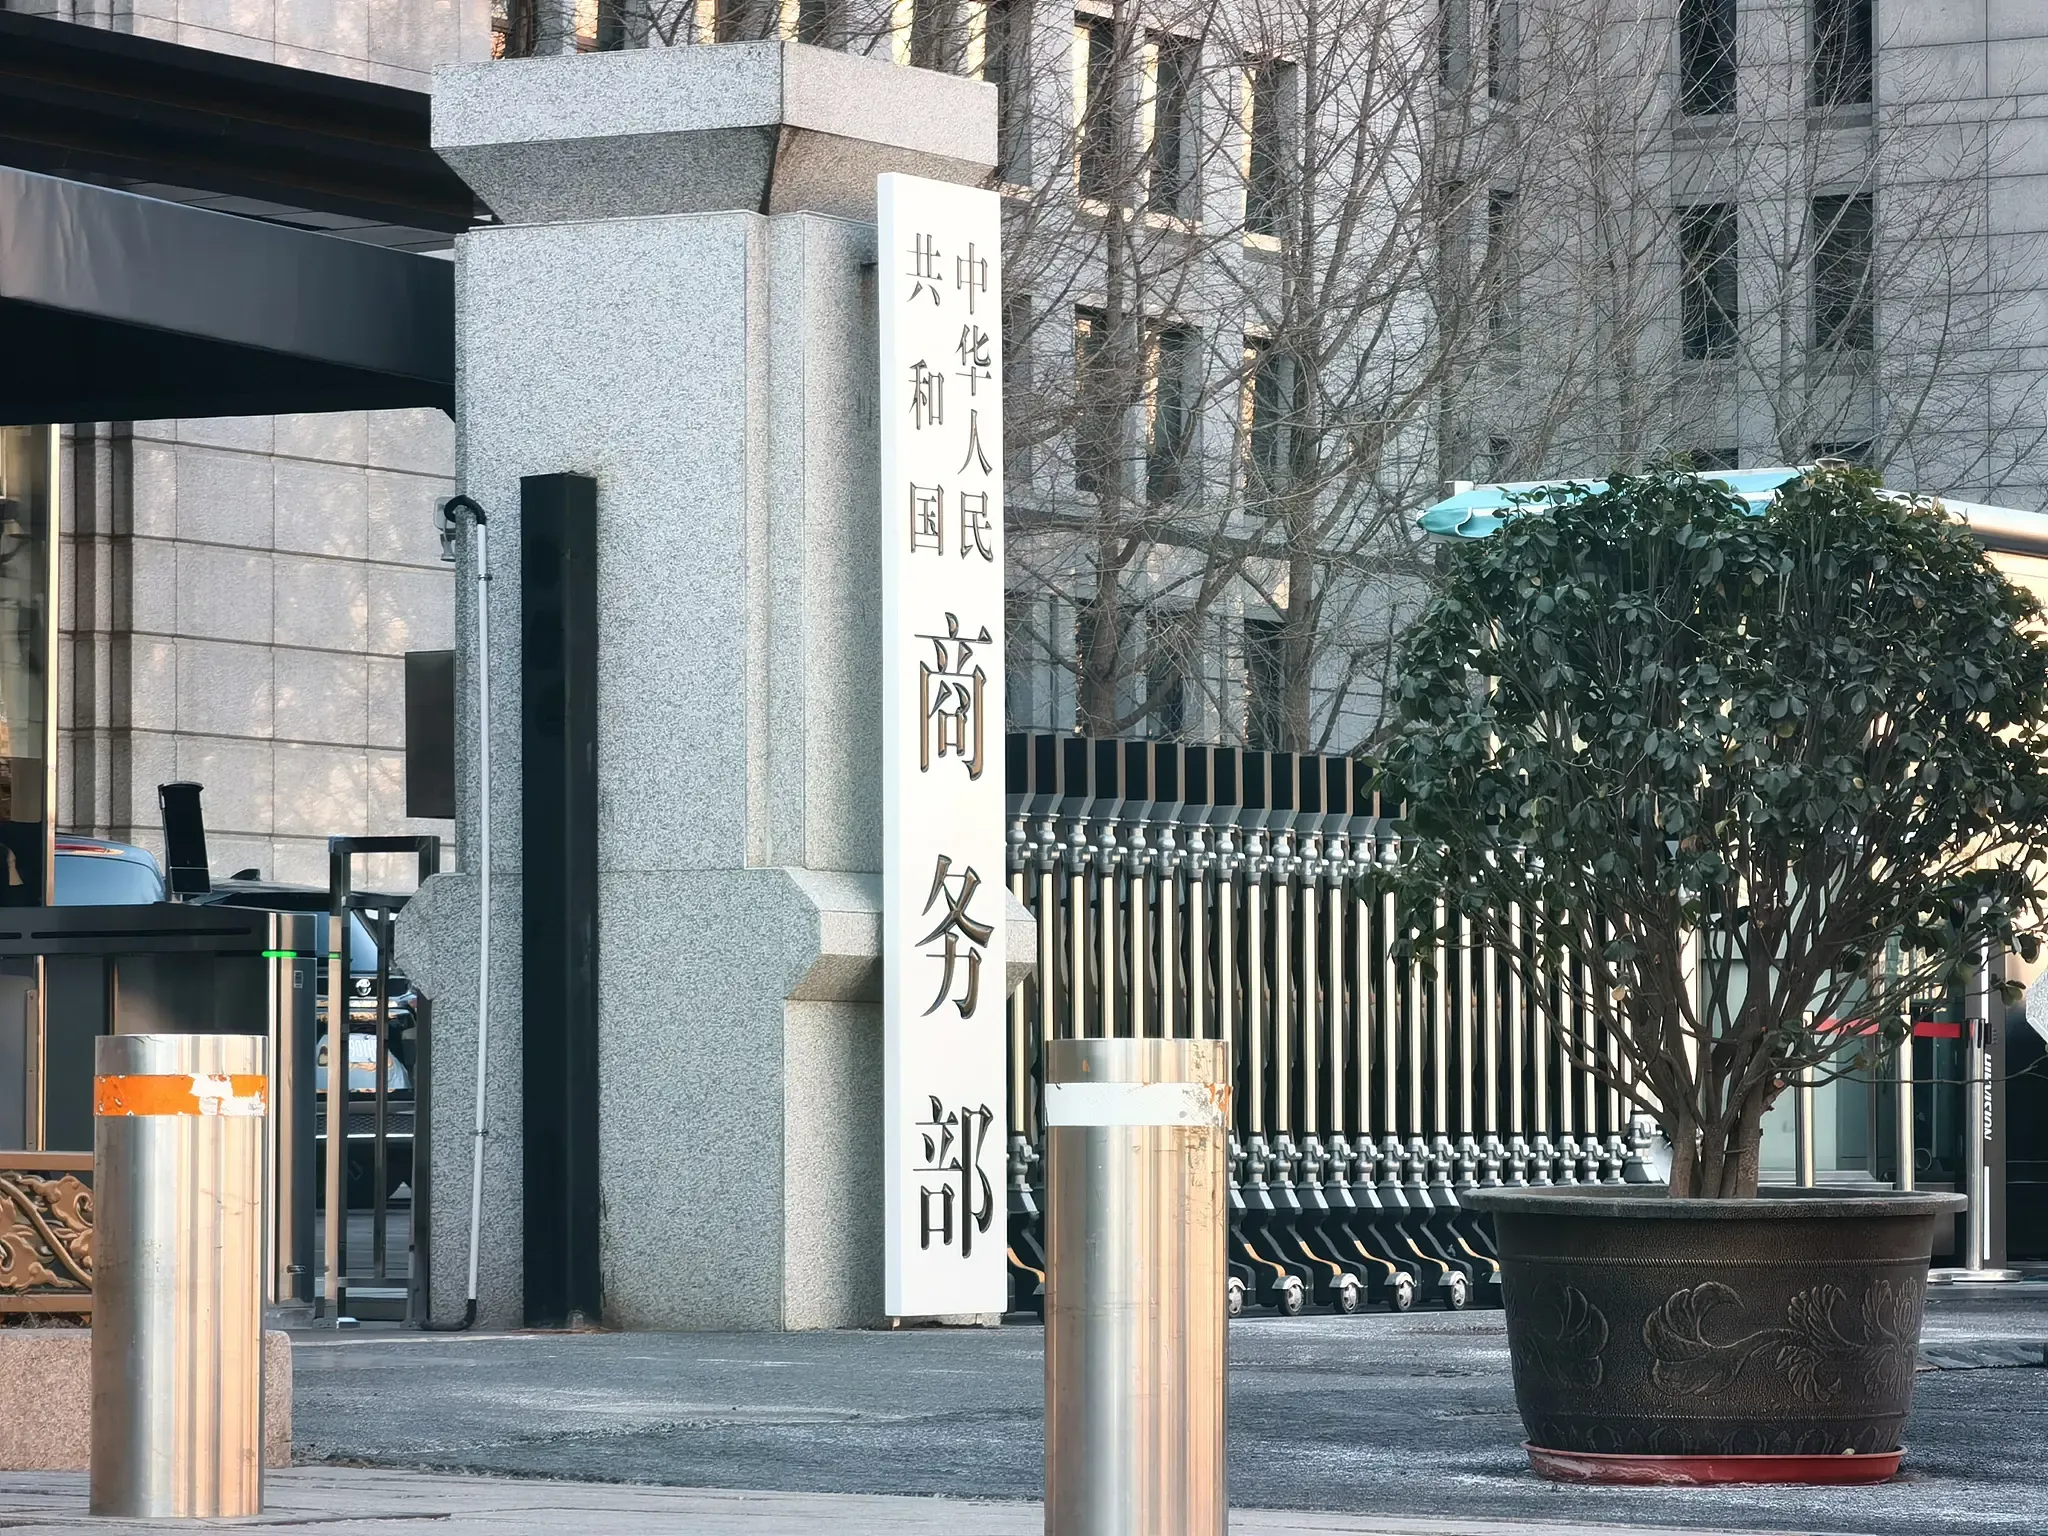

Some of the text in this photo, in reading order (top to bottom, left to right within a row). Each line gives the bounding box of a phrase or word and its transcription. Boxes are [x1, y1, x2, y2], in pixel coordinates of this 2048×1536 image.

[906, 233, 943, 556] 共和国
[955, 242, 993, 563] 中华人民
[913, 611, 994, 1258] 商务部
